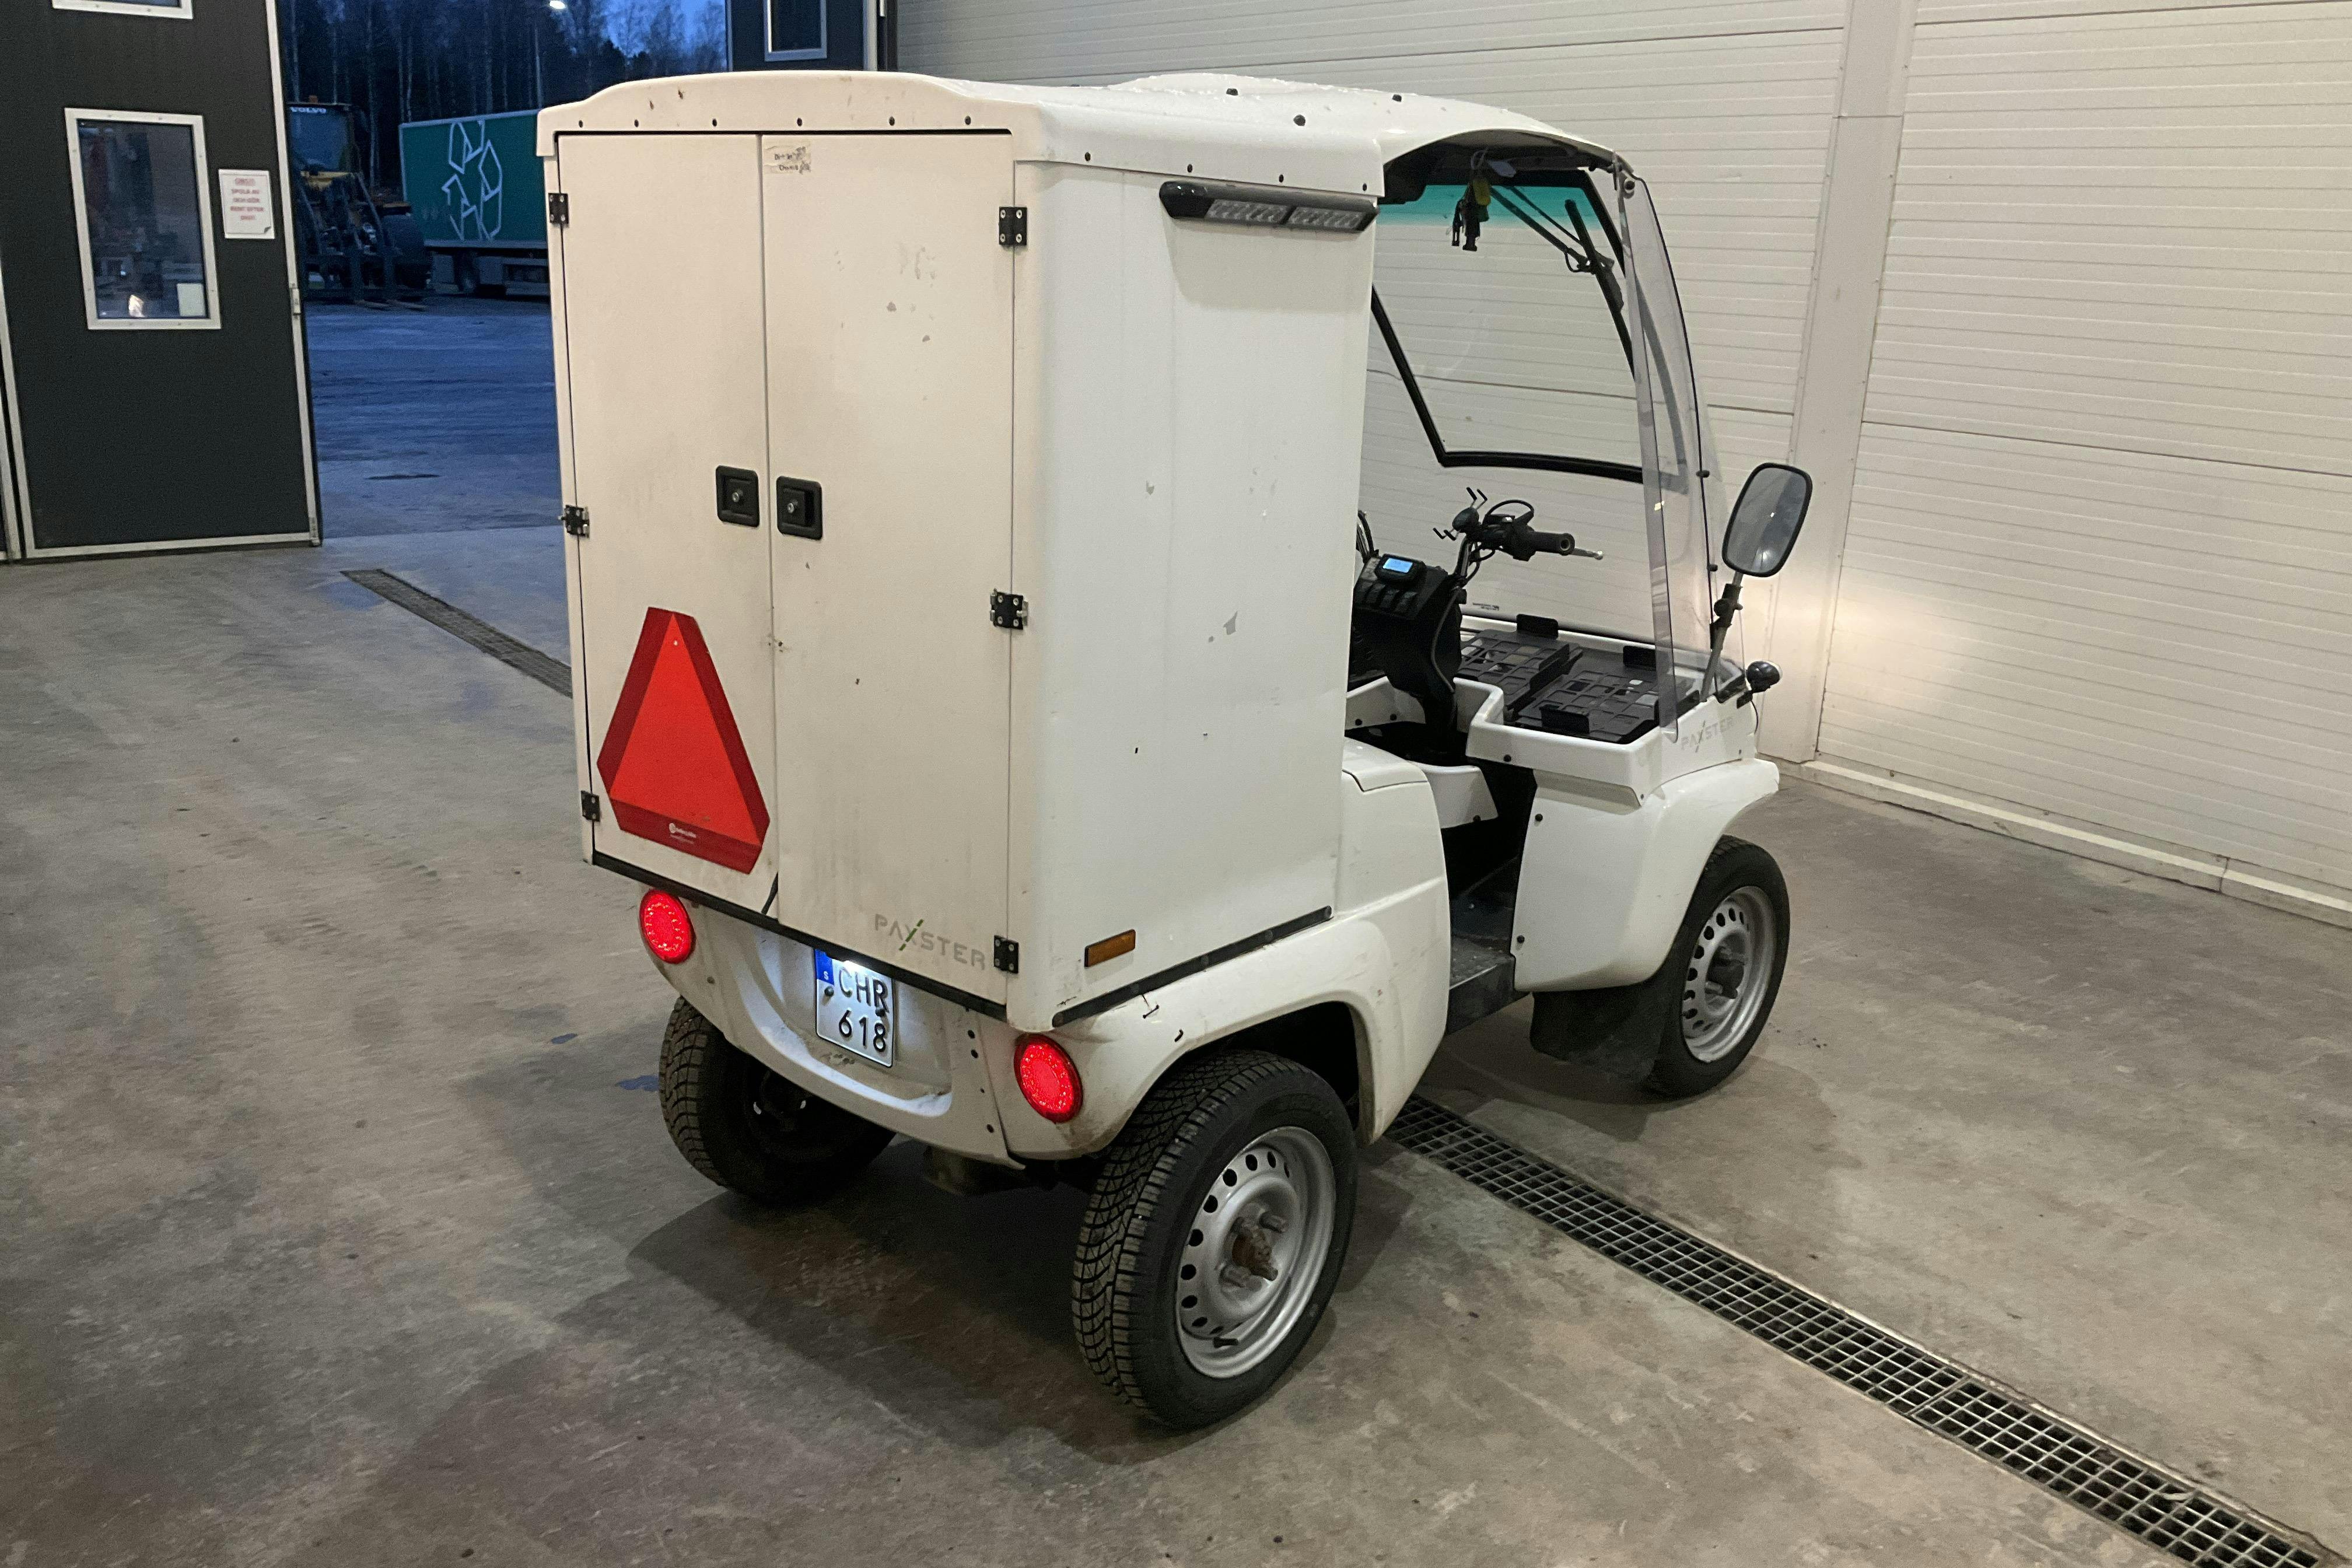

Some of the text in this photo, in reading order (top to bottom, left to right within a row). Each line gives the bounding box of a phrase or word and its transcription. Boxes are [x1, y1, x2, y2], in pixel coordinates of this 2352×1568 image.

[874, 914, 986, 971] PAXSTER
[839, 967, 890, 1013] CHR
[839, 1009, 886, 1052] 618
